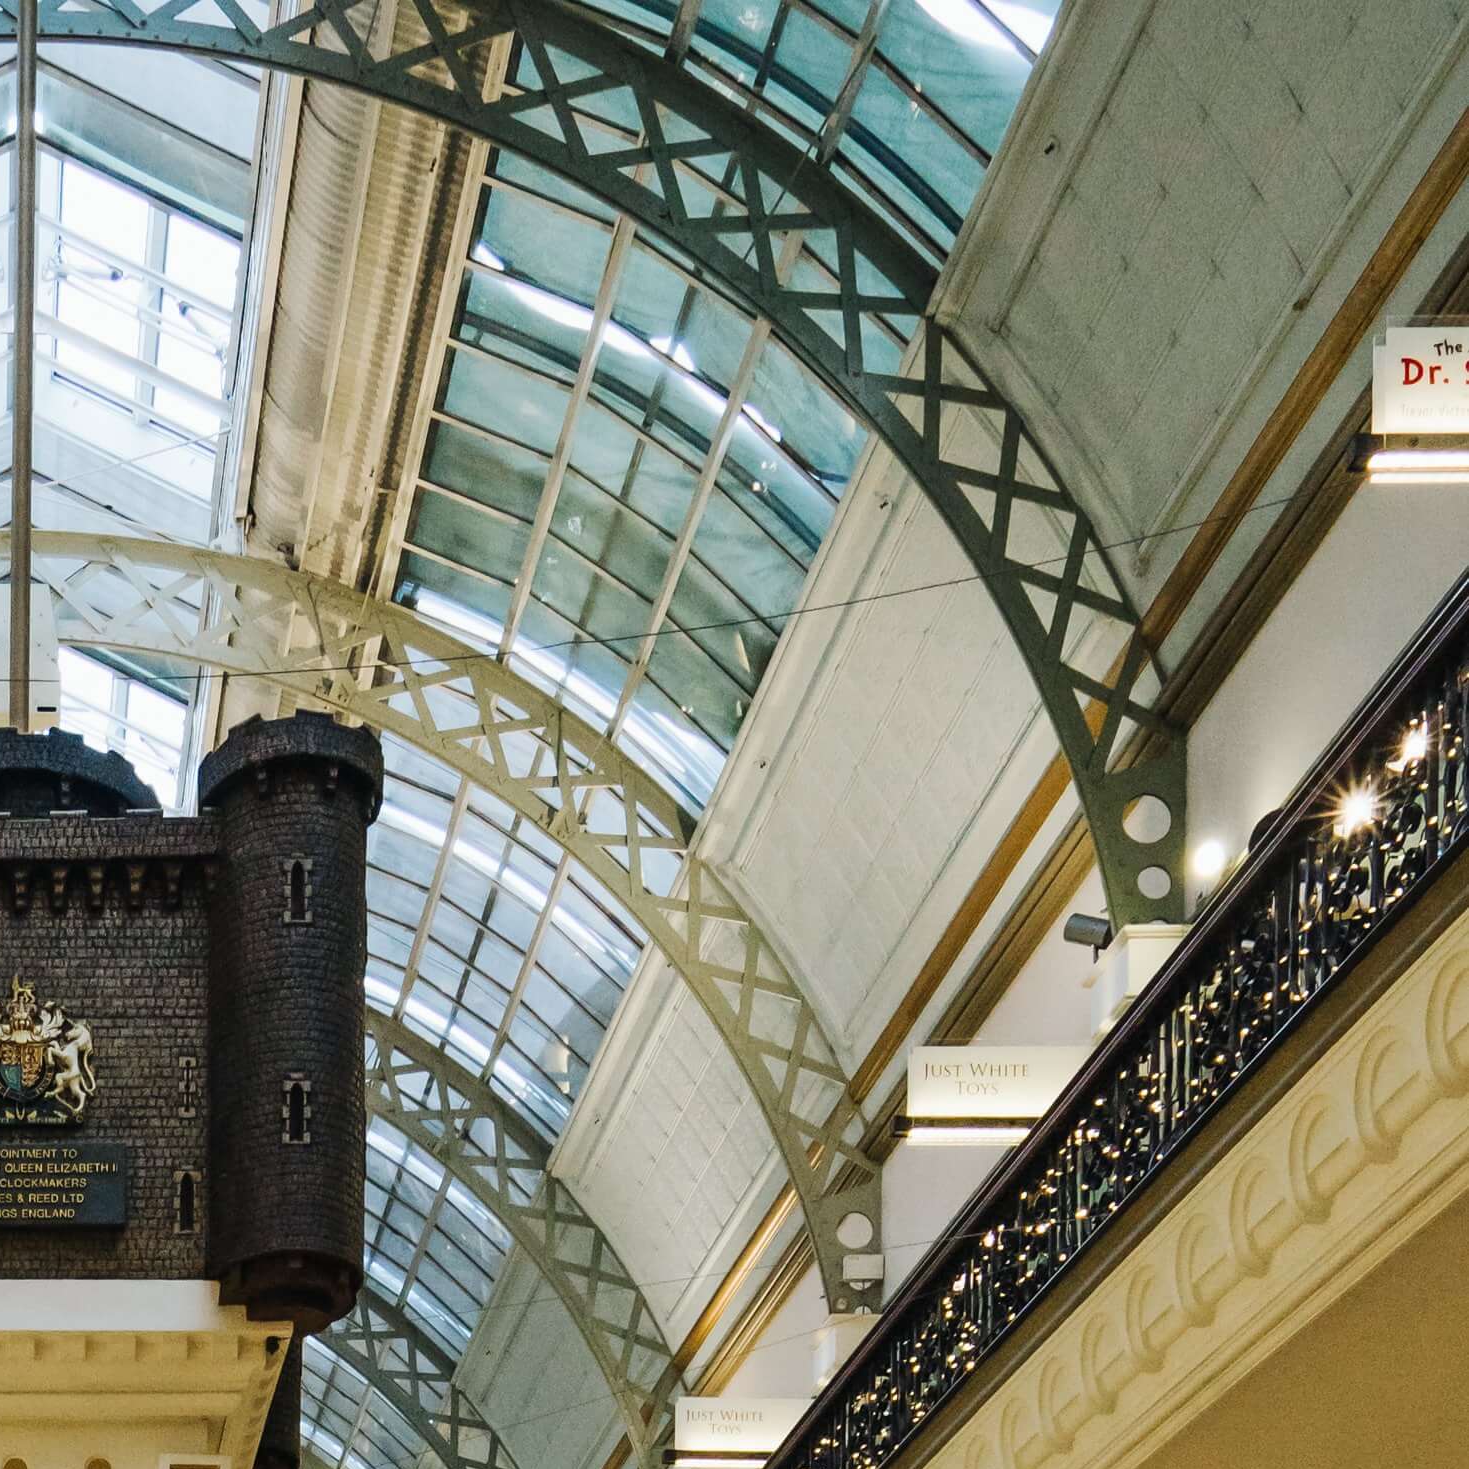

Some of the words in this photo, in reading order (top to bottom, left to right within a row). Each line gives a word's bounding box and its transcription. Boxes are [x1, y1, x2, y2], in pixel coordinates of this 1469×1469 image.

[1434, 339, 1463, 356] The
[1401, 358, 1449, 385] Dr.
[62, 1149, 78, 1159] TO
[4, 1164, 43, 1174] QUEEN
[47, 1163, 109, 1173] ELIZABETH
[0, 1178, 87, 1188] CLOCKMAKERS
[17, 1194, 24, 1203] &
[28, 1194, 59, 1203] REED
[62, 1193, 85, 1203] LTD
[21, 1208, 75, 1218] ENGLAND
